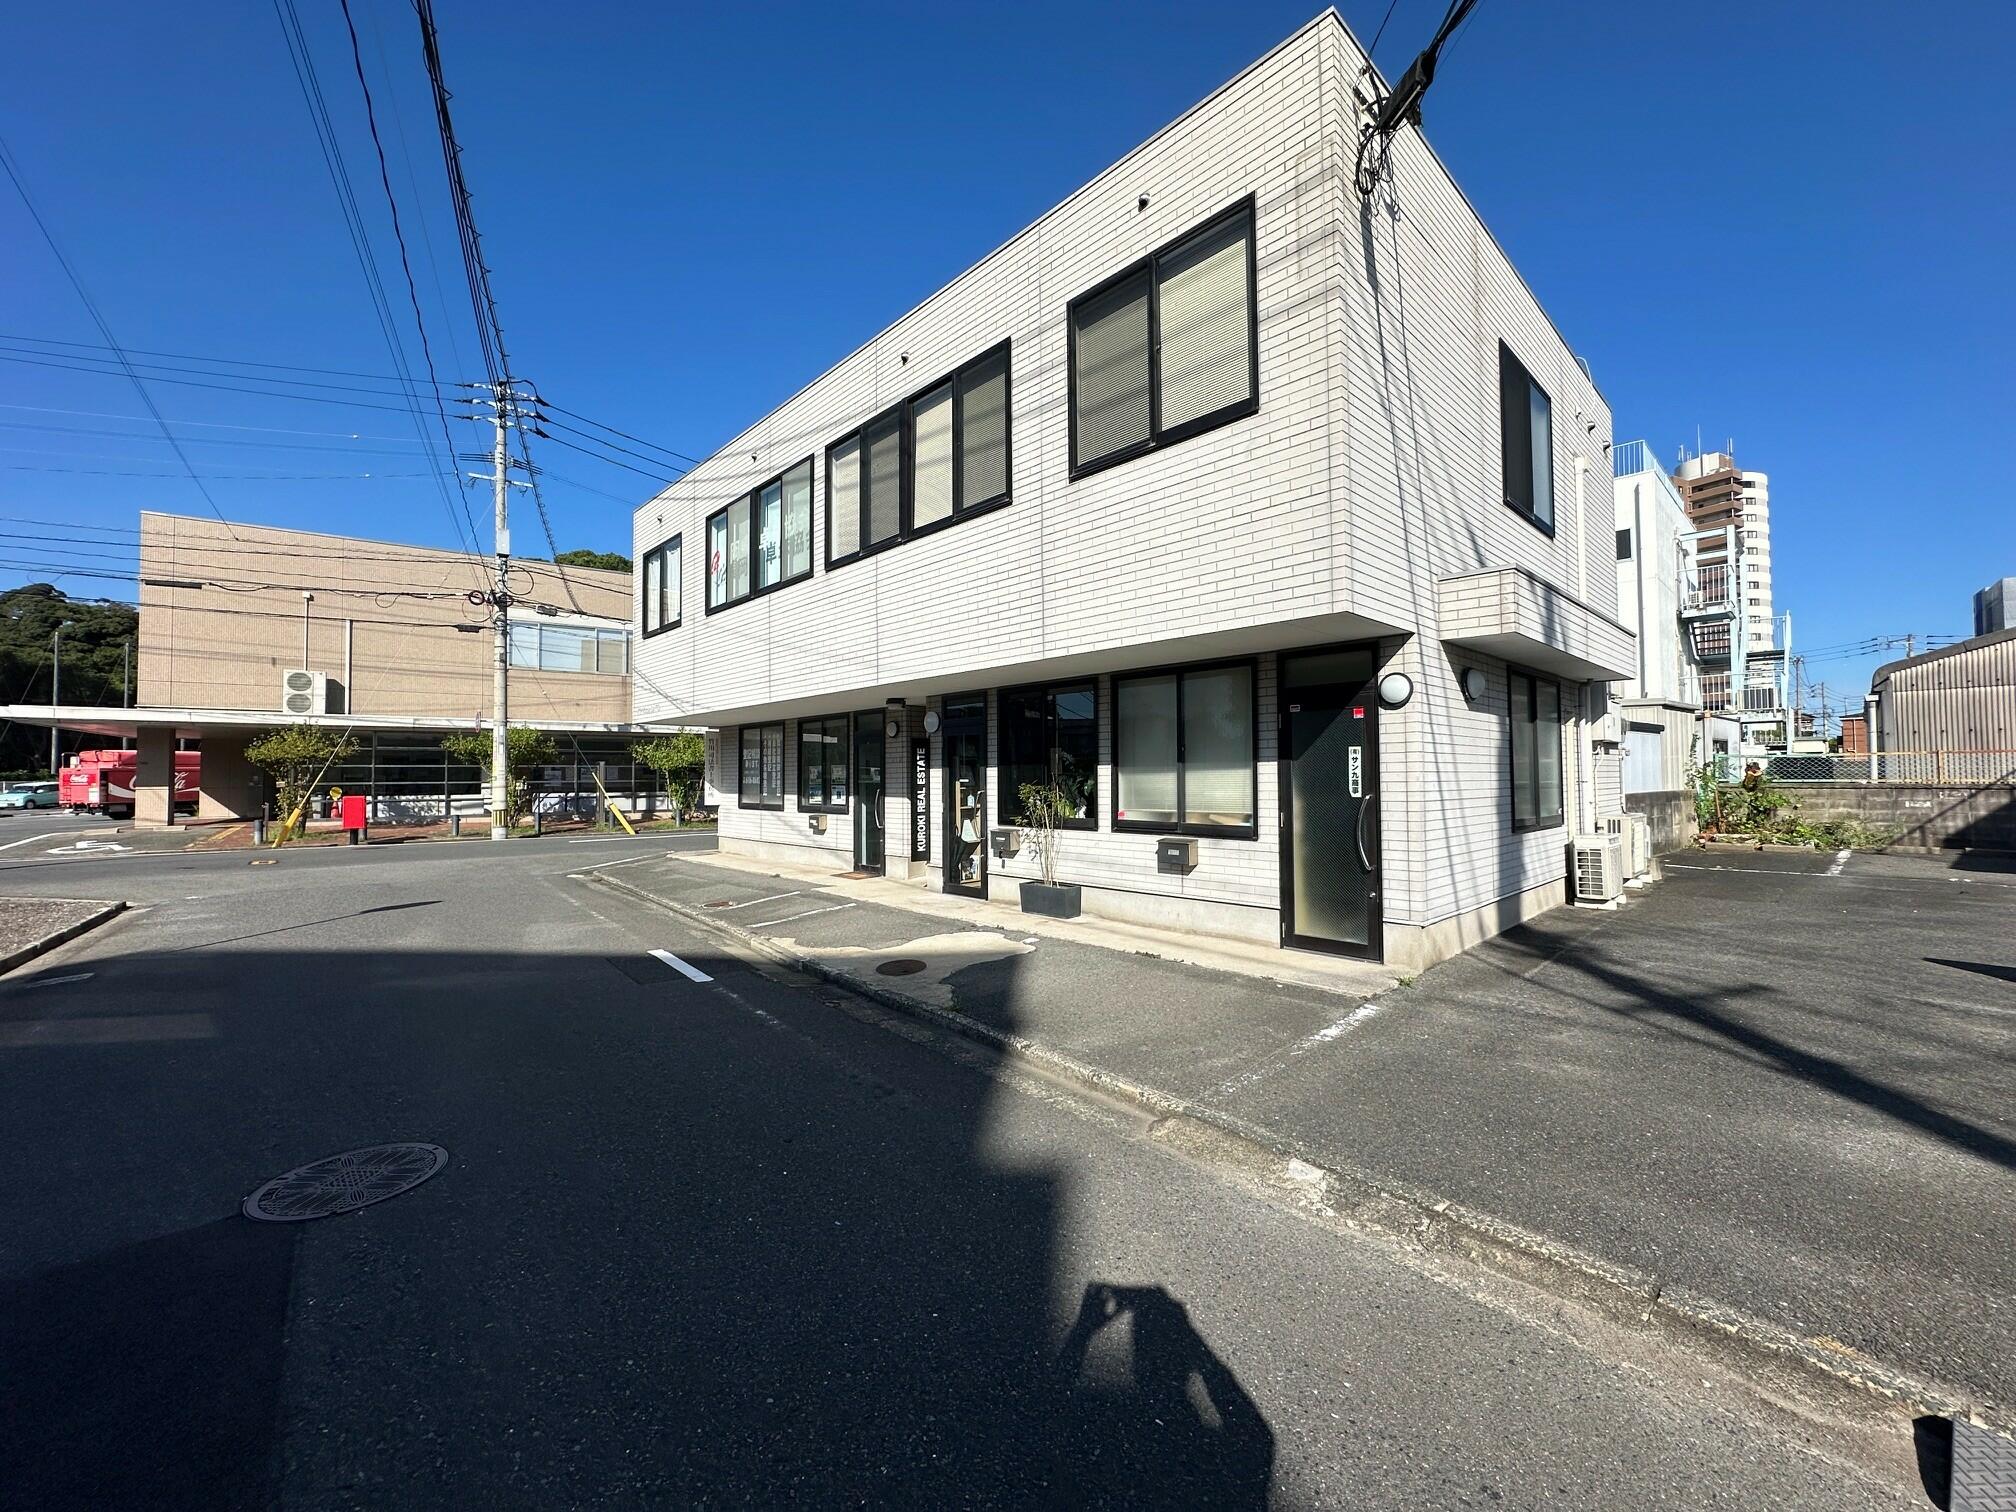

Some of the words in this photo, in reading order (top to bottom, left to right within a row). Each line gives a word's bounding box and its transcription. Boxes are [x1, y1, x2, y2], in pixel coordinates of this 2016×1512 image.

[917, 748, 926, 785] ESTATE
[917, 787, 926, 813] REAL
[917, 815, 926, 852] KUROKI
